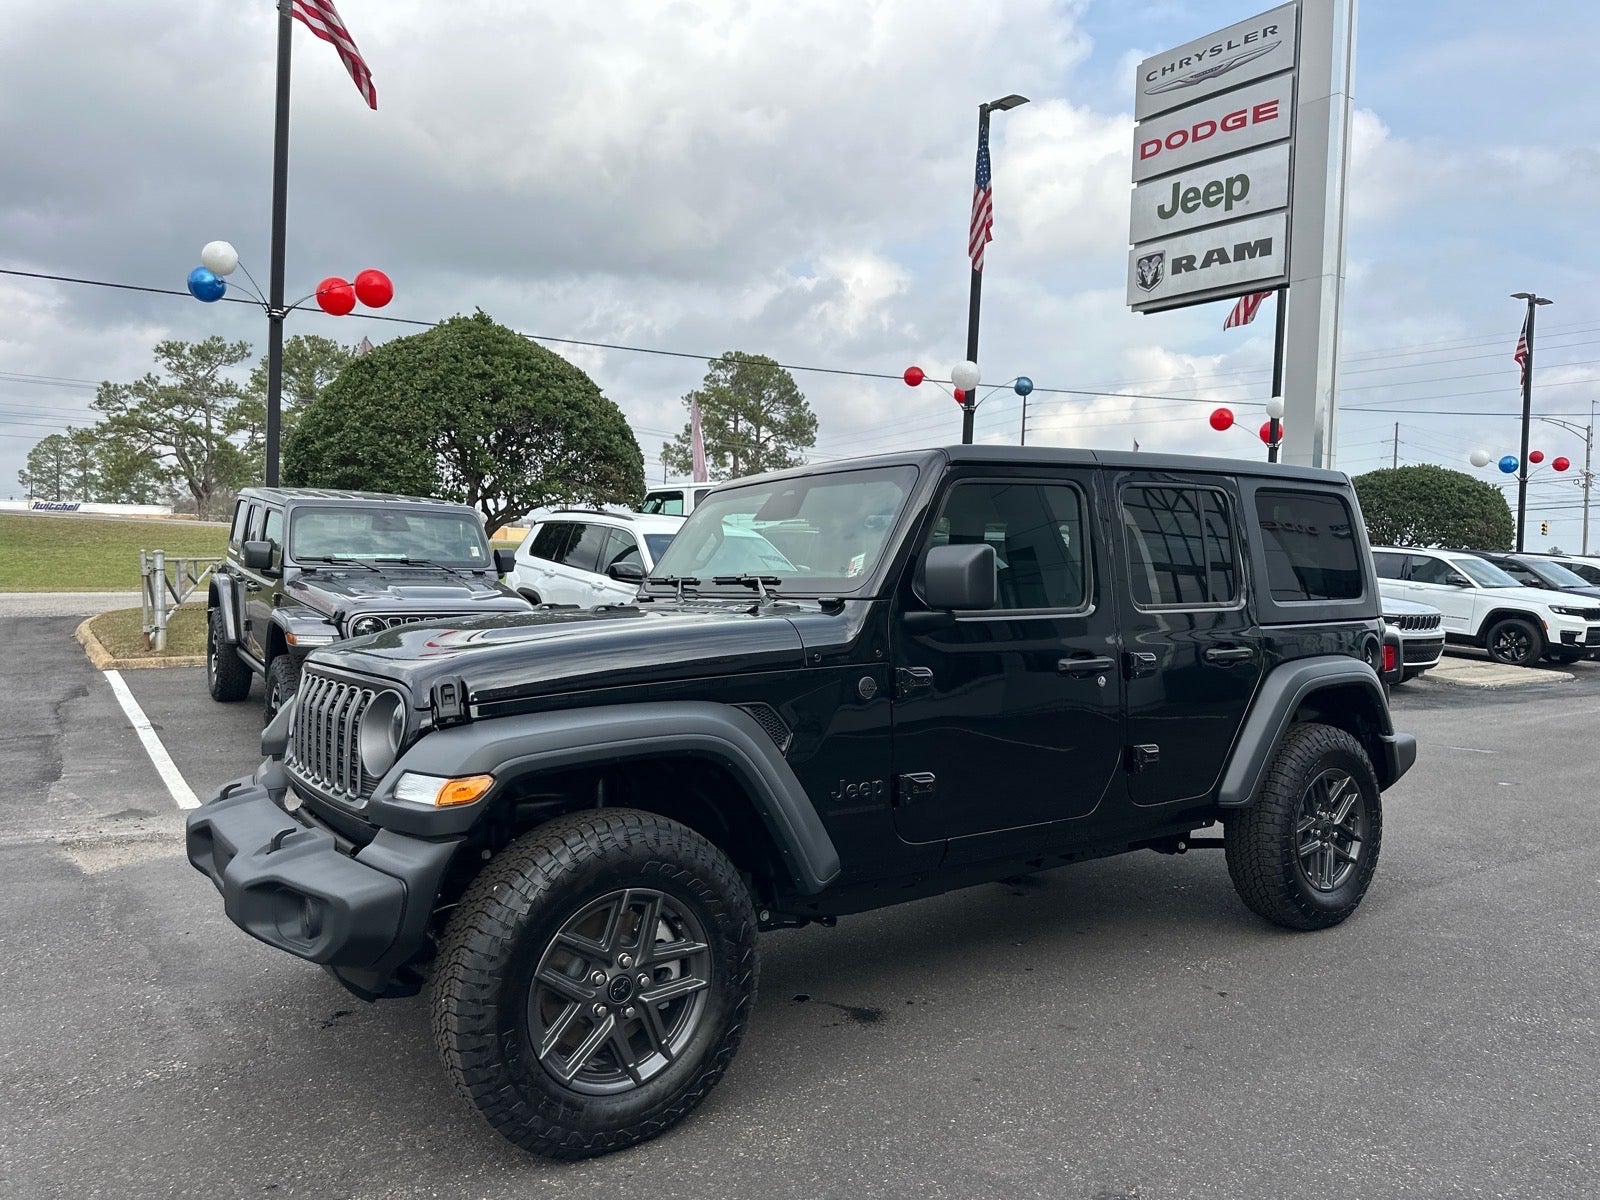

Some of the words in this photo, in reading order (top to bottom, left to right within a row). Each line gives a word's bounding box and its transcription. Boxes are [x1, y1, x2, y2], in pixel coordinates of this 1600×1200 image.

[1145, 24, 1279, 82] CHRYSLER
[1140, 99, 1280, 161] DODGE
[1157, 173, 1250, 220] Jeep
[1171, 237, 1273, 276] RAM
[32, 501, 81, 511] Twitchell
[830, 779, 884, 800] Jeep
